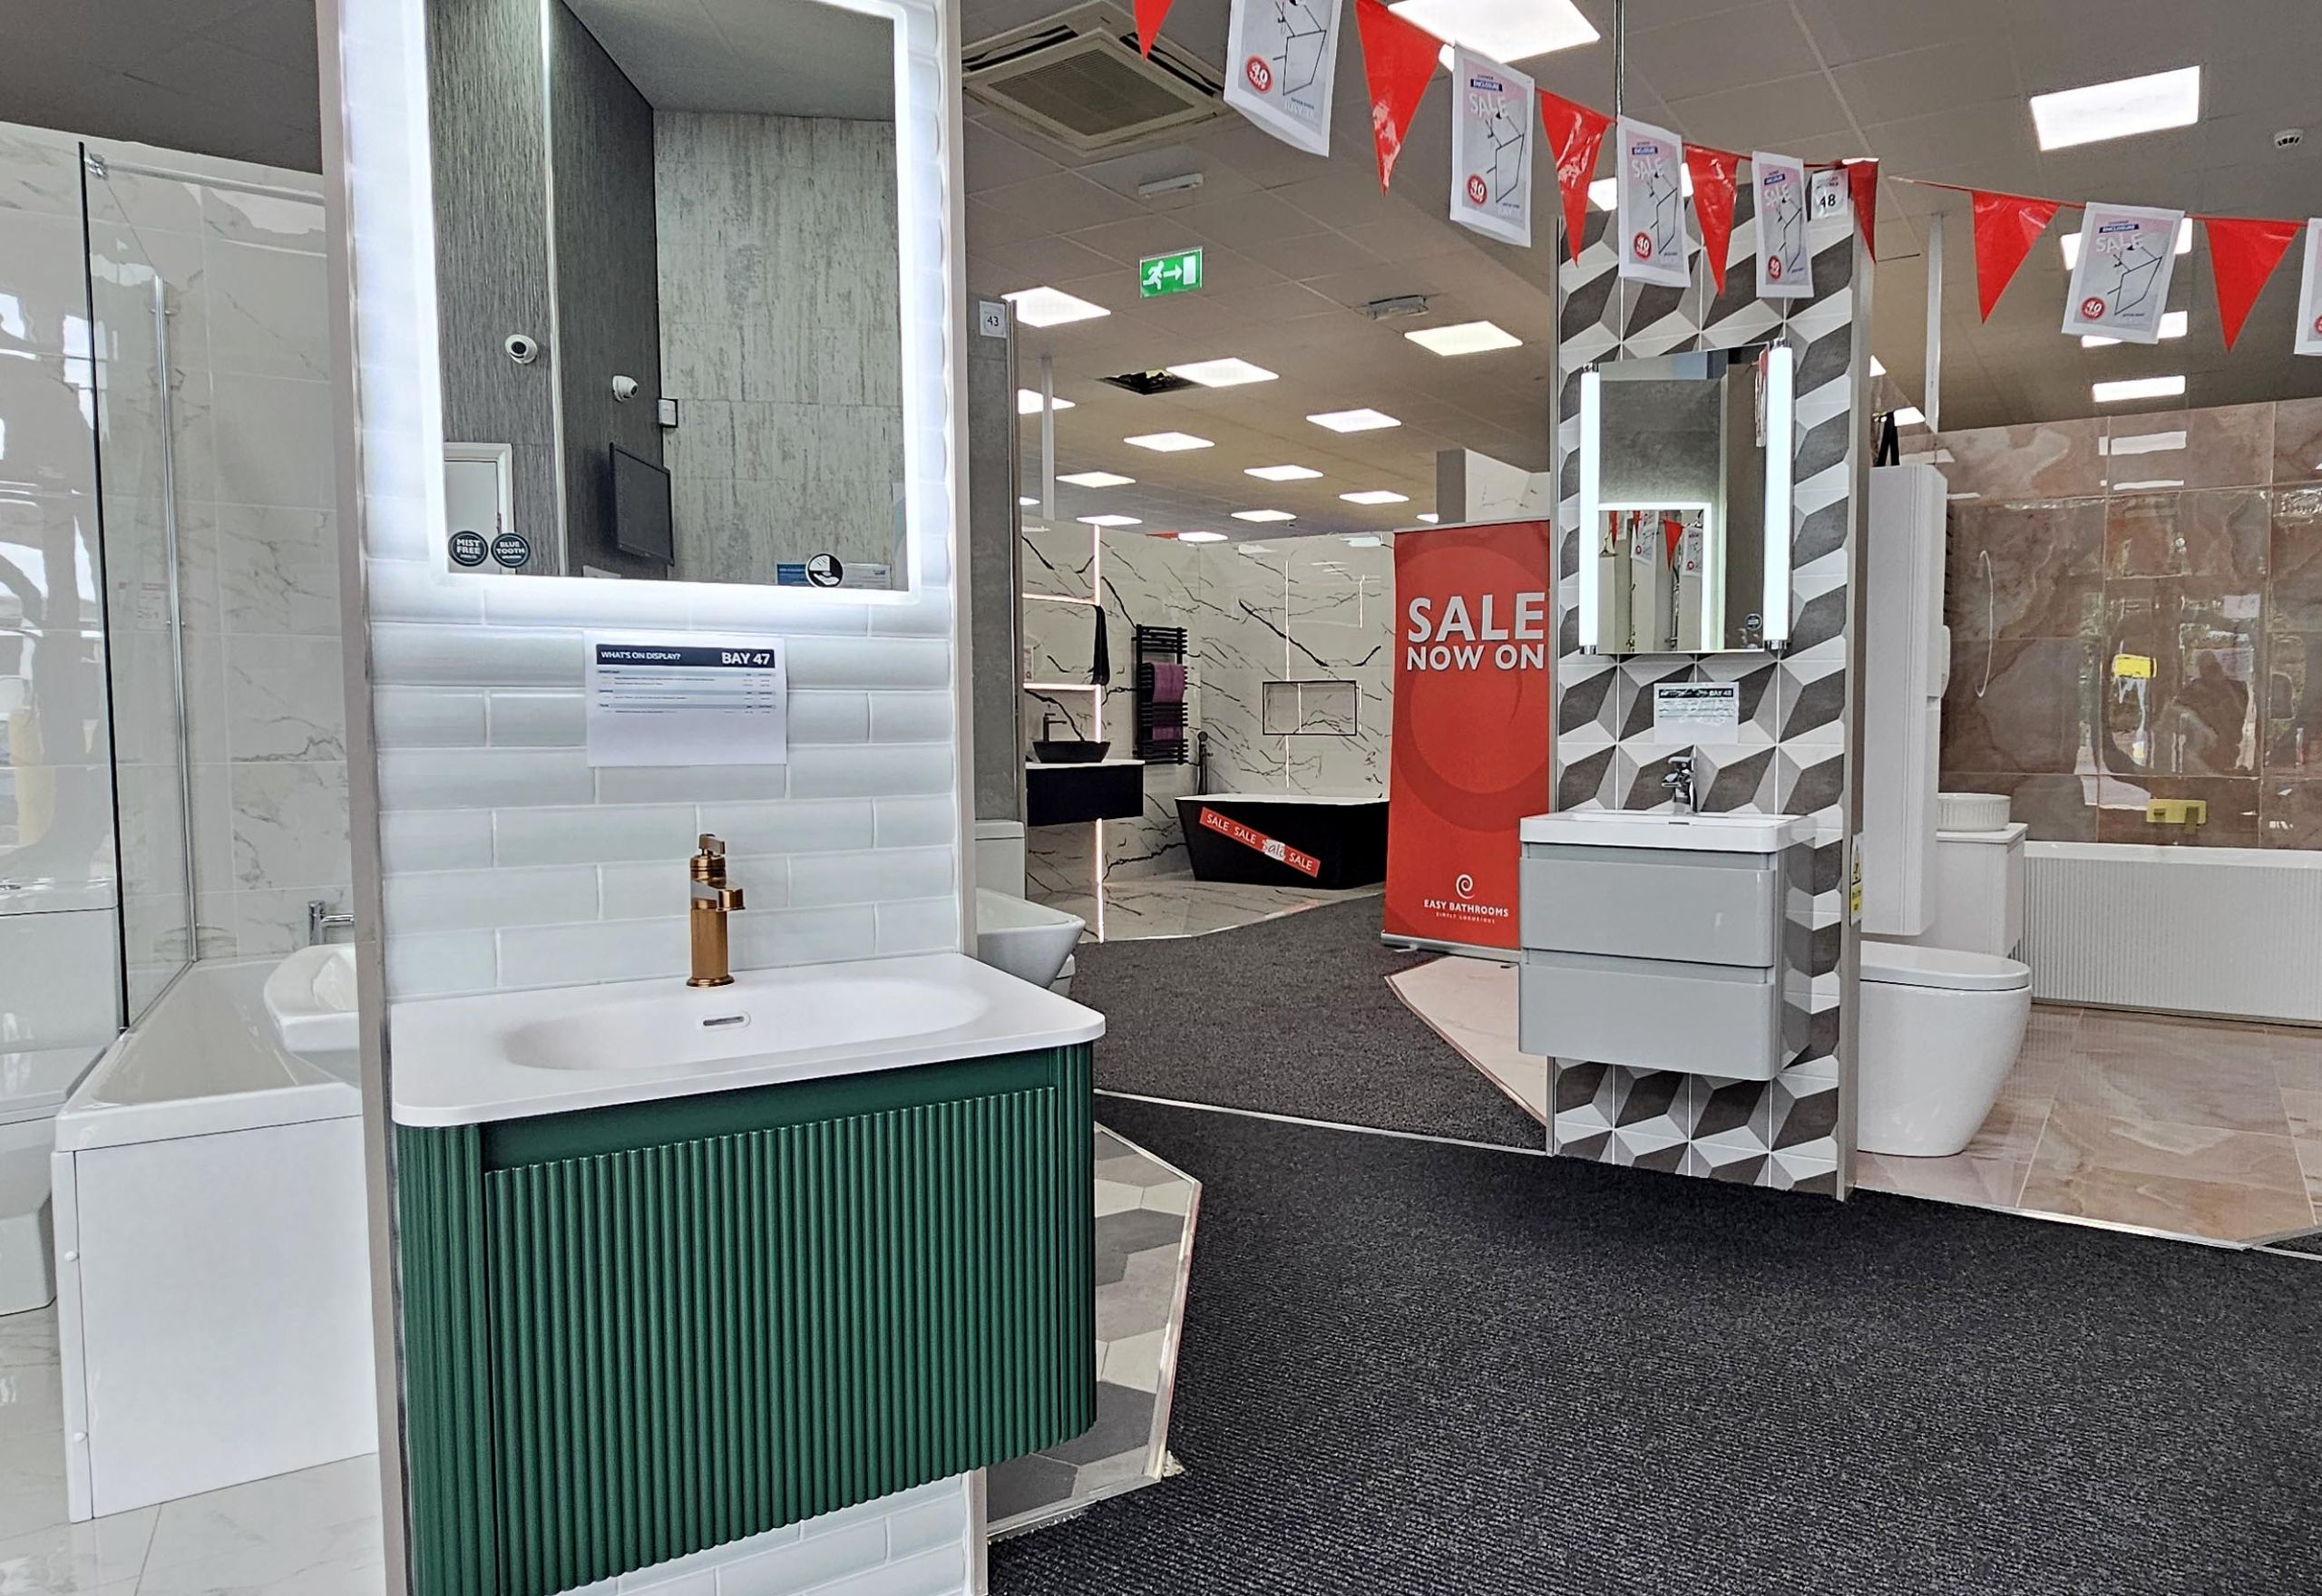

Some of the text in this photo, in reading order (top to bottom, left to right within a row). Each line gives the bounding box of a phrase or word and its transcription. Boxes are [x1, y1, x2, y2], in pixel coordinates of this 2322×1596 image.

[1469, 92, 1507, 119] SALE
[1820, 193, 1836, 209] 48
[2096, 232, 2142, 253] SALE
[987, 316, 999, 326] 43
[456, 539, 480, 547] MIST
[456, 546, 481, 554] FREE
[1408, 592, 1546, 643] SALE
[631, 651, 645, 659] ON
[646, 652, 681, 660] DISPLAY?
[722, 651, 770, 666] BAY 47
[1407, 644, 1545, 671] NOW ON
[1206, 813, 1230, 832] SALE
[1234, 826, 1257, 844] SALE
[1289, 852, 1313, 871] SALE
[1424, 899, 1509, 917] EASY BATHROOMS
